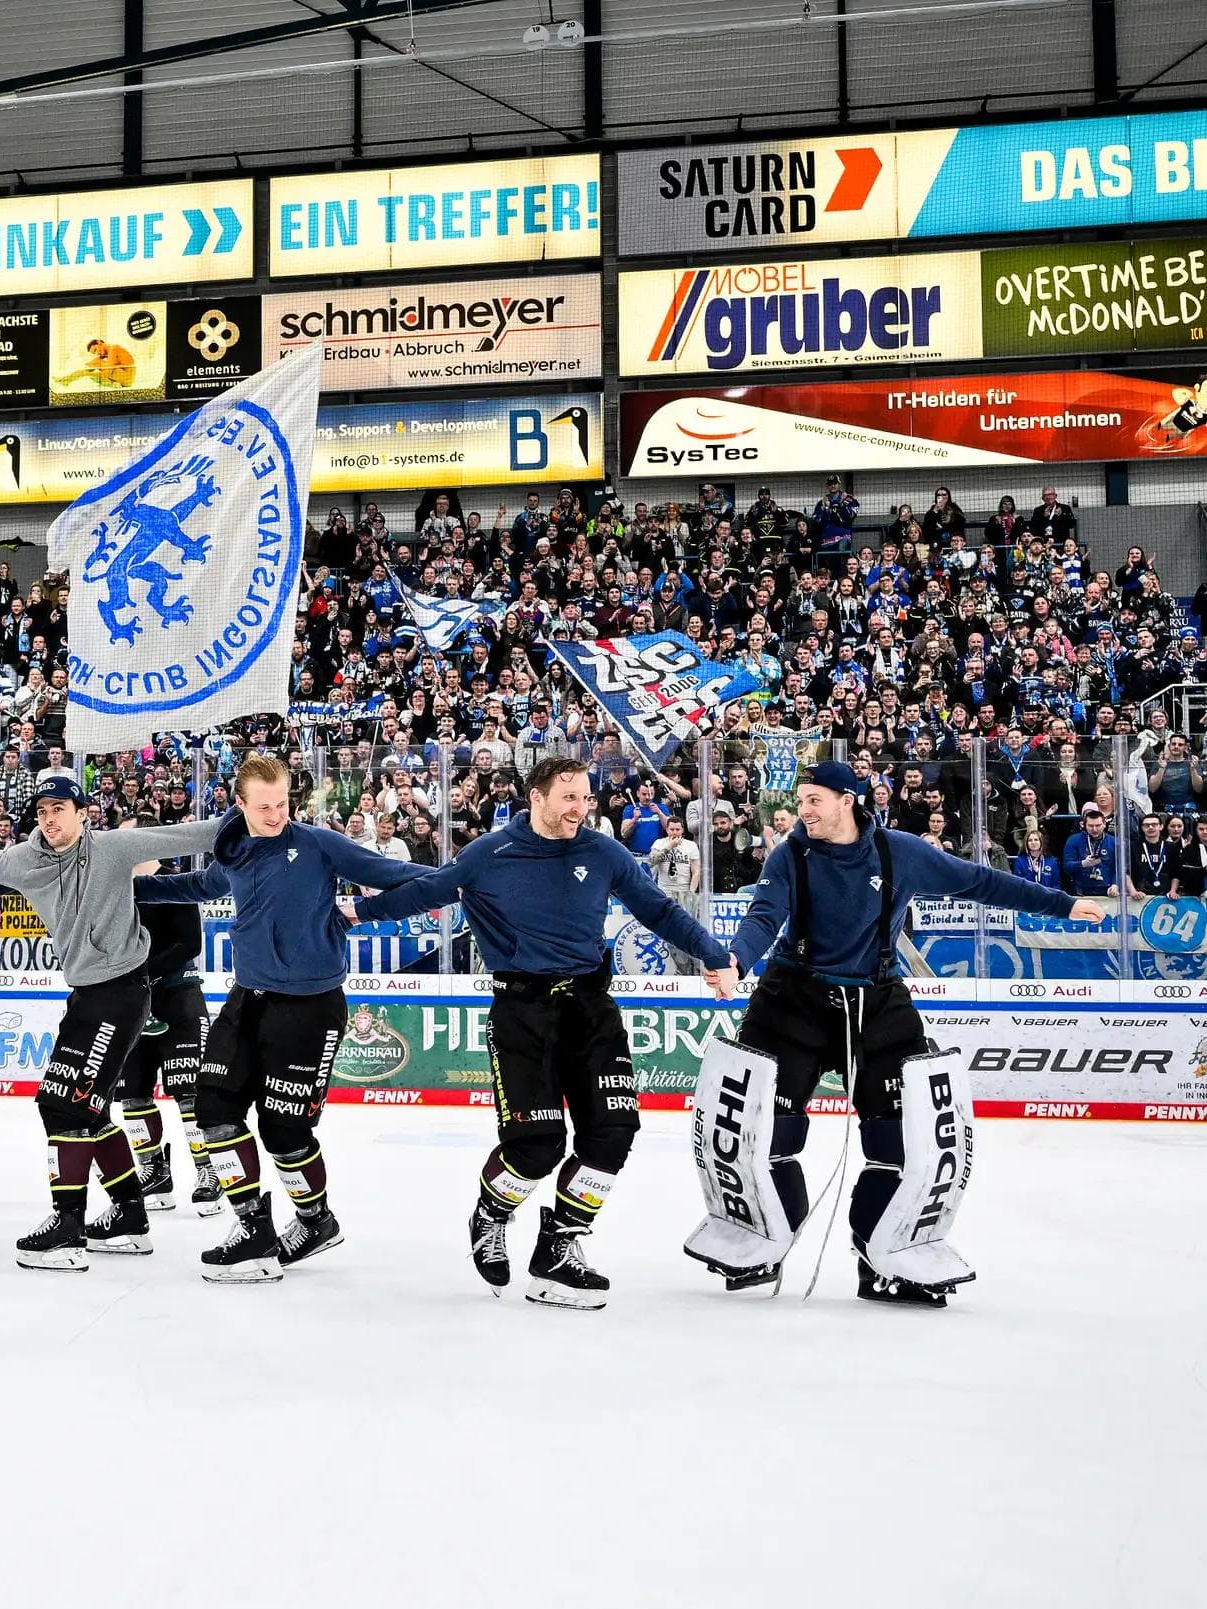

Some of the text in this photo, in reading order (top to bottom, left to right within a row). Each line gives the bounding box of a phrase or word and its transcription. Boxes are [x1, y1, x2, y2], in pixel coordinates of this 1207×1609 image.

[659, 151, 817, 200] SATURN
[1020, 144, 1133, 203] DAS
[280, 181, 599, 250] EIN TREFFER!
[705, 193, 817, 238] CARD
[711, 264, 817, 295] MÖBEL
[280, 295, 565, 347] schmidmeyer
[704, 278, 941, 370] gruber
[324, 340, 465, 361] Erdbau Abbruch
[751, 358, 828, 367] Siemensstr.
[854, 351, 943, 362] Gaimersheim
[186, 364, 241, 376] elements
[407, 358, 582, 379] www.schmidmeyer.net
[887, 388, 1018, 410] IT-Helden für
[339, 421, 392, 438] Support
[396, 421, 407, 433] &
[410, 417, 499, 436] Development
[979, 411, 1122, 431] Unternehmen
[37, 435, 155, 452] Linux/Open Source
[794, 421, 949, 458] www.systec-computer.de
[646, 444, 759, 465] SysTec
[577, 641, 696, 693] ZSC
[629, 692, 657, 711] SEIT
[915, 900, 972, 911] United we
[920, 913, 1009, 927] Divided fall!
[1151, 903, 1199, 943] 64
[19, 976, 53, 987] Audi
[386, 979, 421, 990] Audi
[643, 982, 679, 993] Audi
[909, 984, 946, 995] Audi
[1053, 986, 1092, 996] Audi
[83, 1021, 117, 1079] SATURN
[316, 1029, 339, 1088] SATURN
[163, 1057, 200, 1071] HERRN
[167, 1073, 197, 1086] BRÄU
[265, 1075, 313, 1098] HERRN
[264, 1096, 305, 1116] BRÄU
[713, 1067, 752, 1227] BÜCHL
[909, 1072, 958, 1242] BÜCHL
